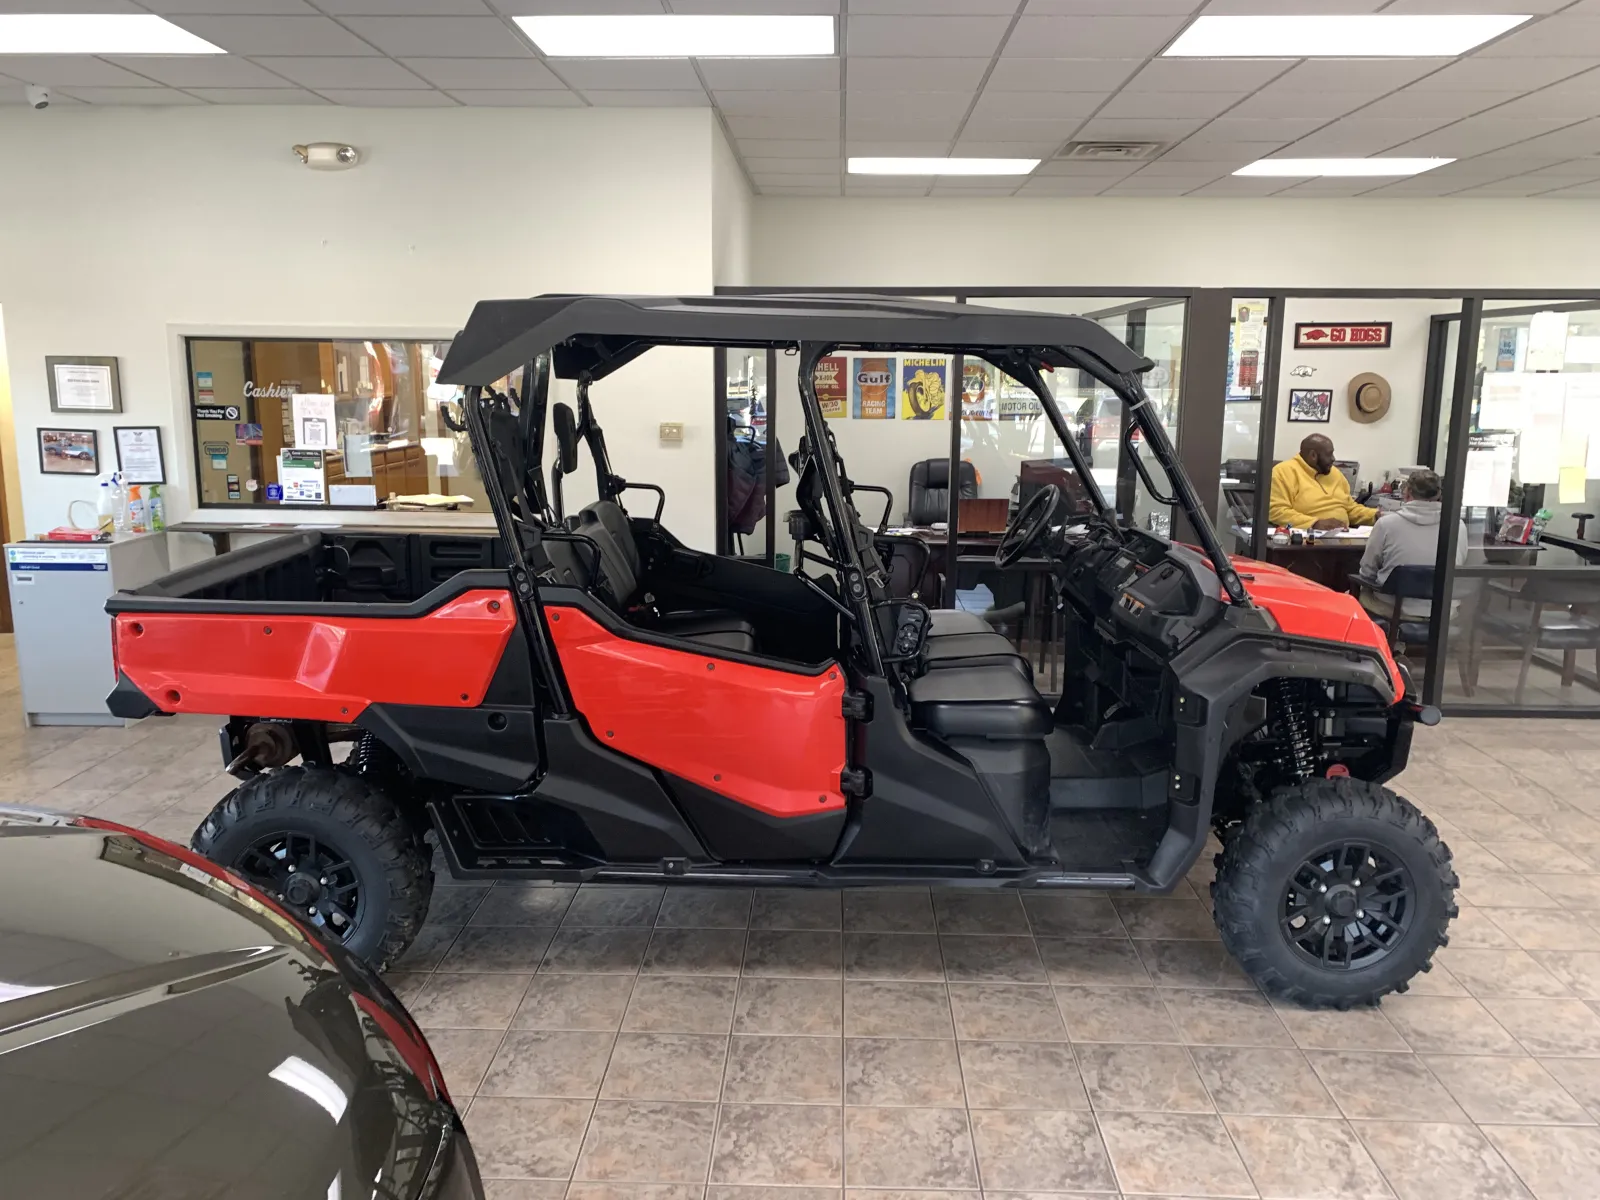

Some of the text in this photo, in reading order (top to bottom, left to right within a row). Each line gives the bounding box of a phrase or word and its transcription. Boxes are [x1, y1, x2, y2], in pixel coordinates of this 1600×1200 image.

[1330, 328, 1382, 342] GO HOGS
[816, 362, 839, 371] HELL
[904, 359, 945, 367] MICHELIN
[858, 373, 890, 383] Gulf
[243, 381, 293, 398] Cashier
[865, 407, 883, 415] TEAM
[1001, 402, 1040, 411] MOTOR OIL
